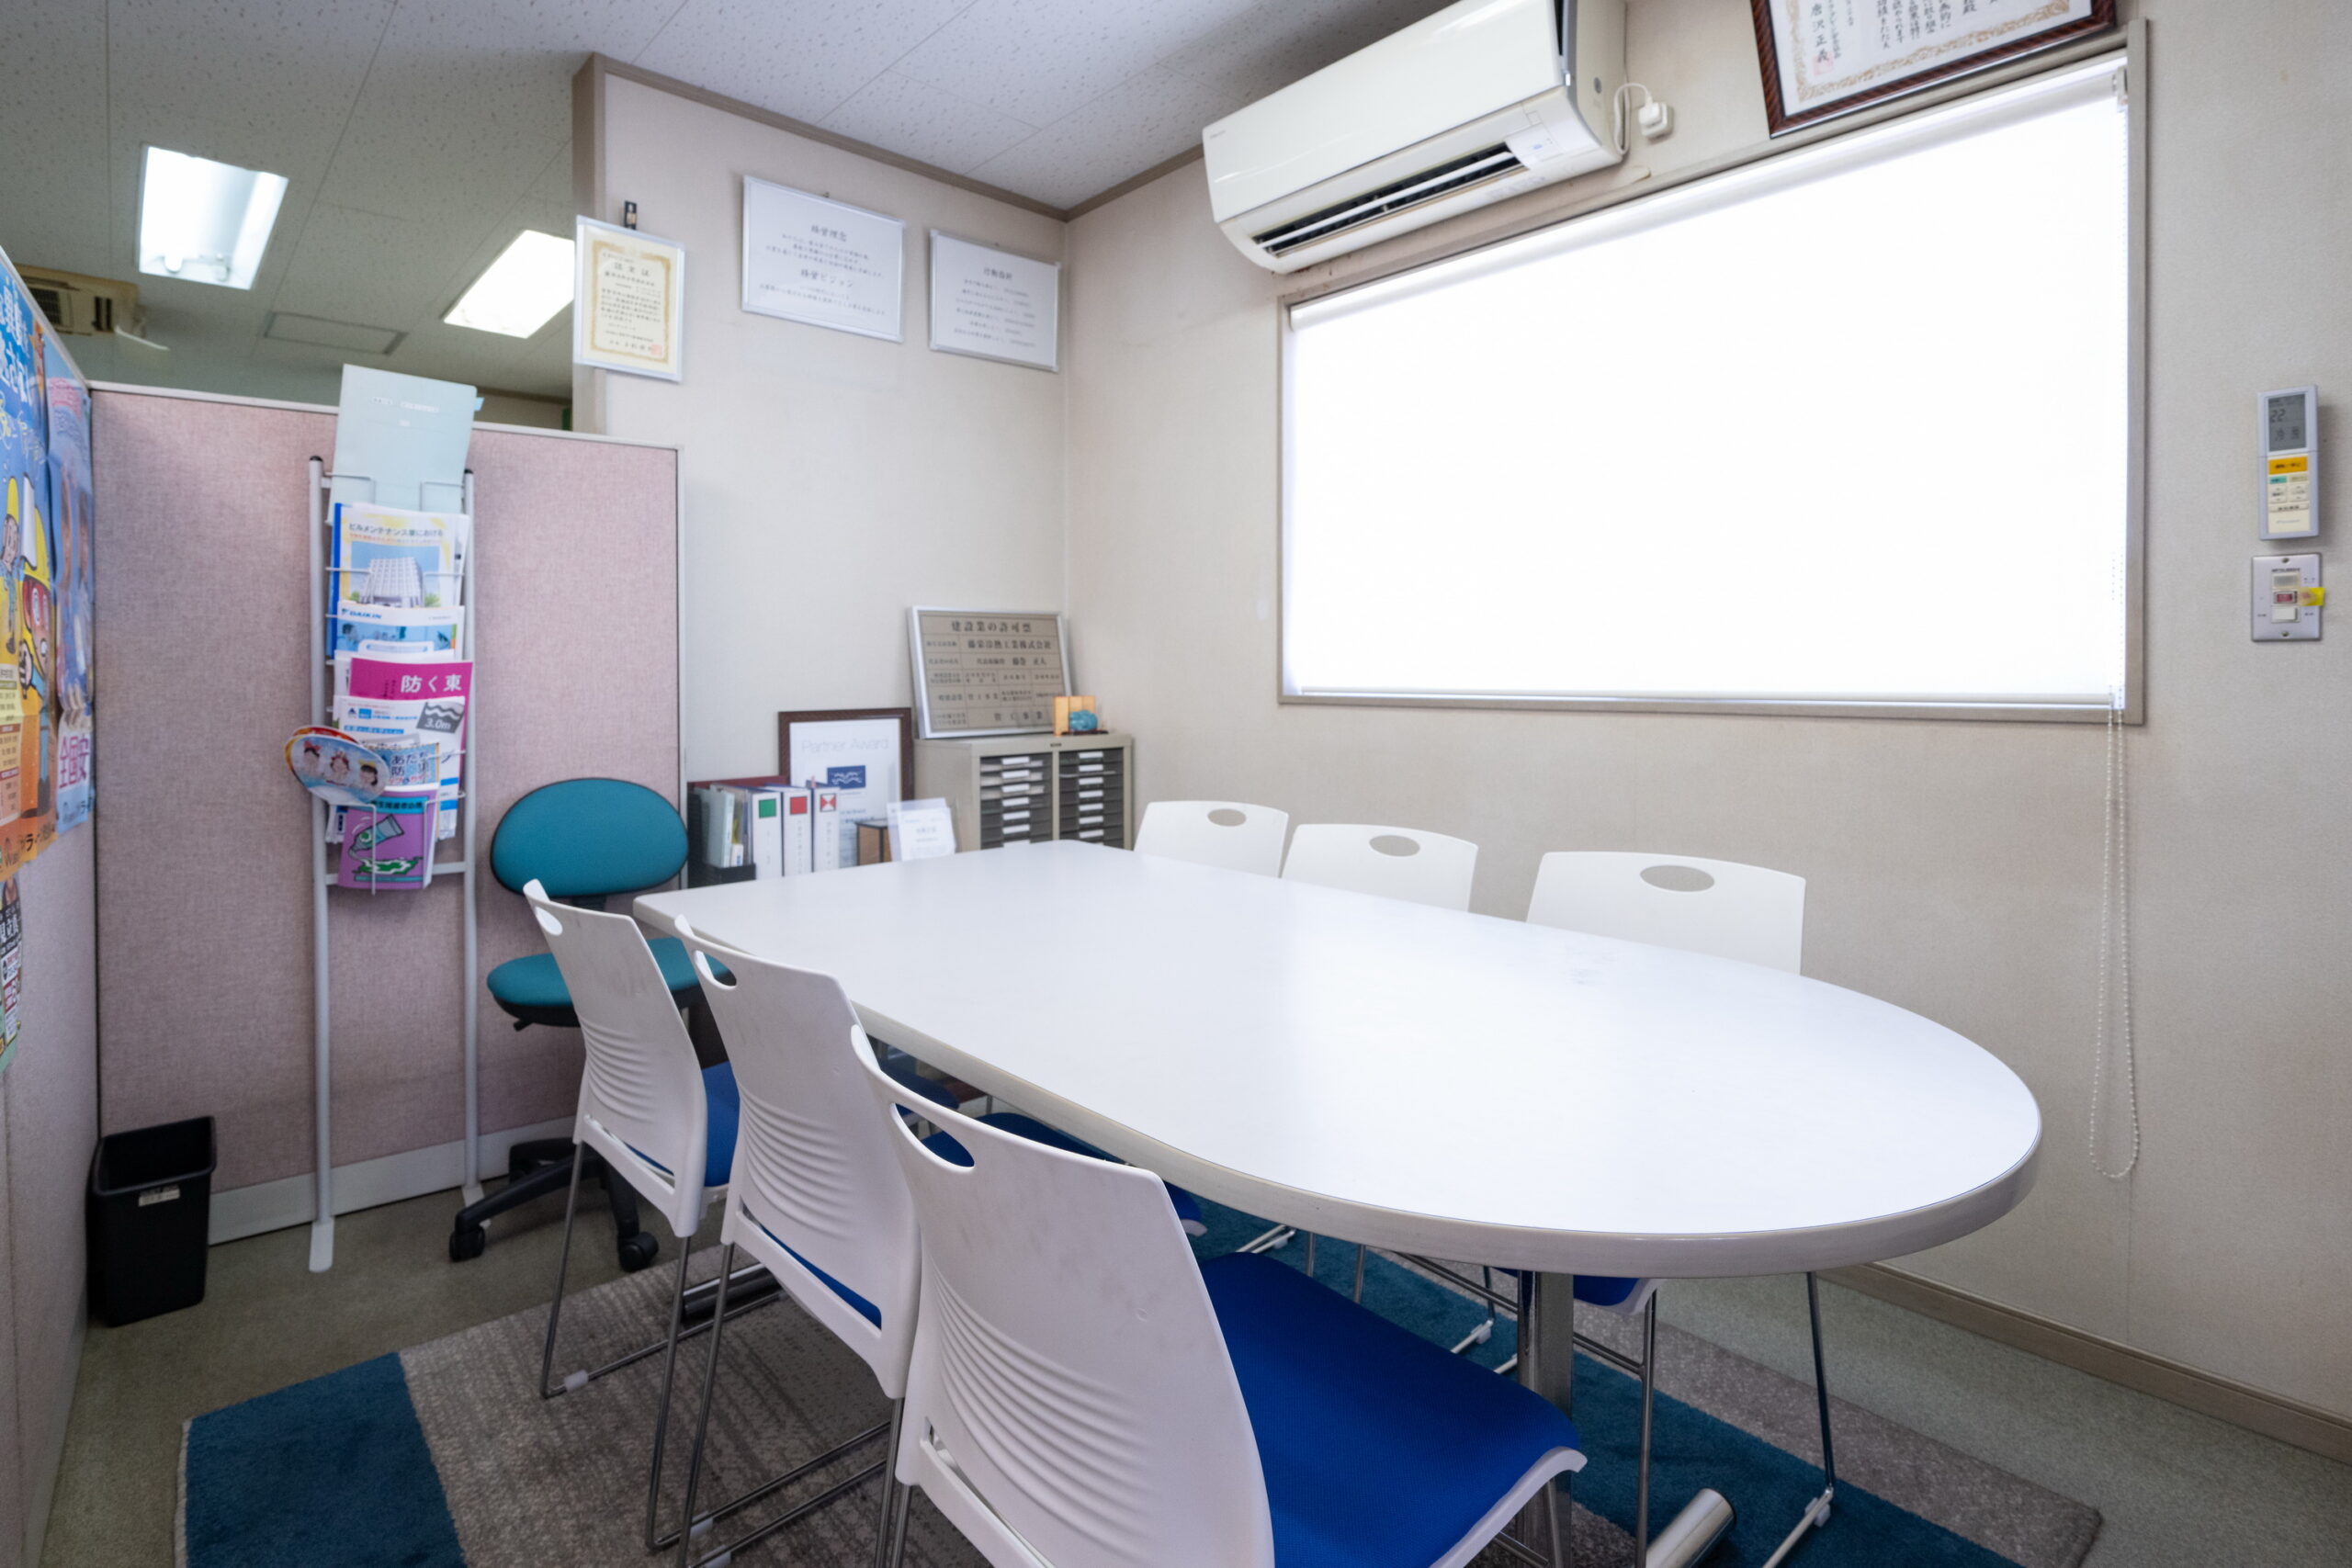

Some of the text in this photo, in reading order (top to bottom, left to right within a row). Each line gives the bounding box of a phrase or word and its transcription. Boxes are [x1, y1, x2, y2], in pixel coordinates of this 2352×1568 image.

[952, 621, 1032, 633] 建設業の許可票
[401, 675, 422, 694] 防
[424, 716, 452, 730] 3.0m
[850, 738, 889, 750] Award
